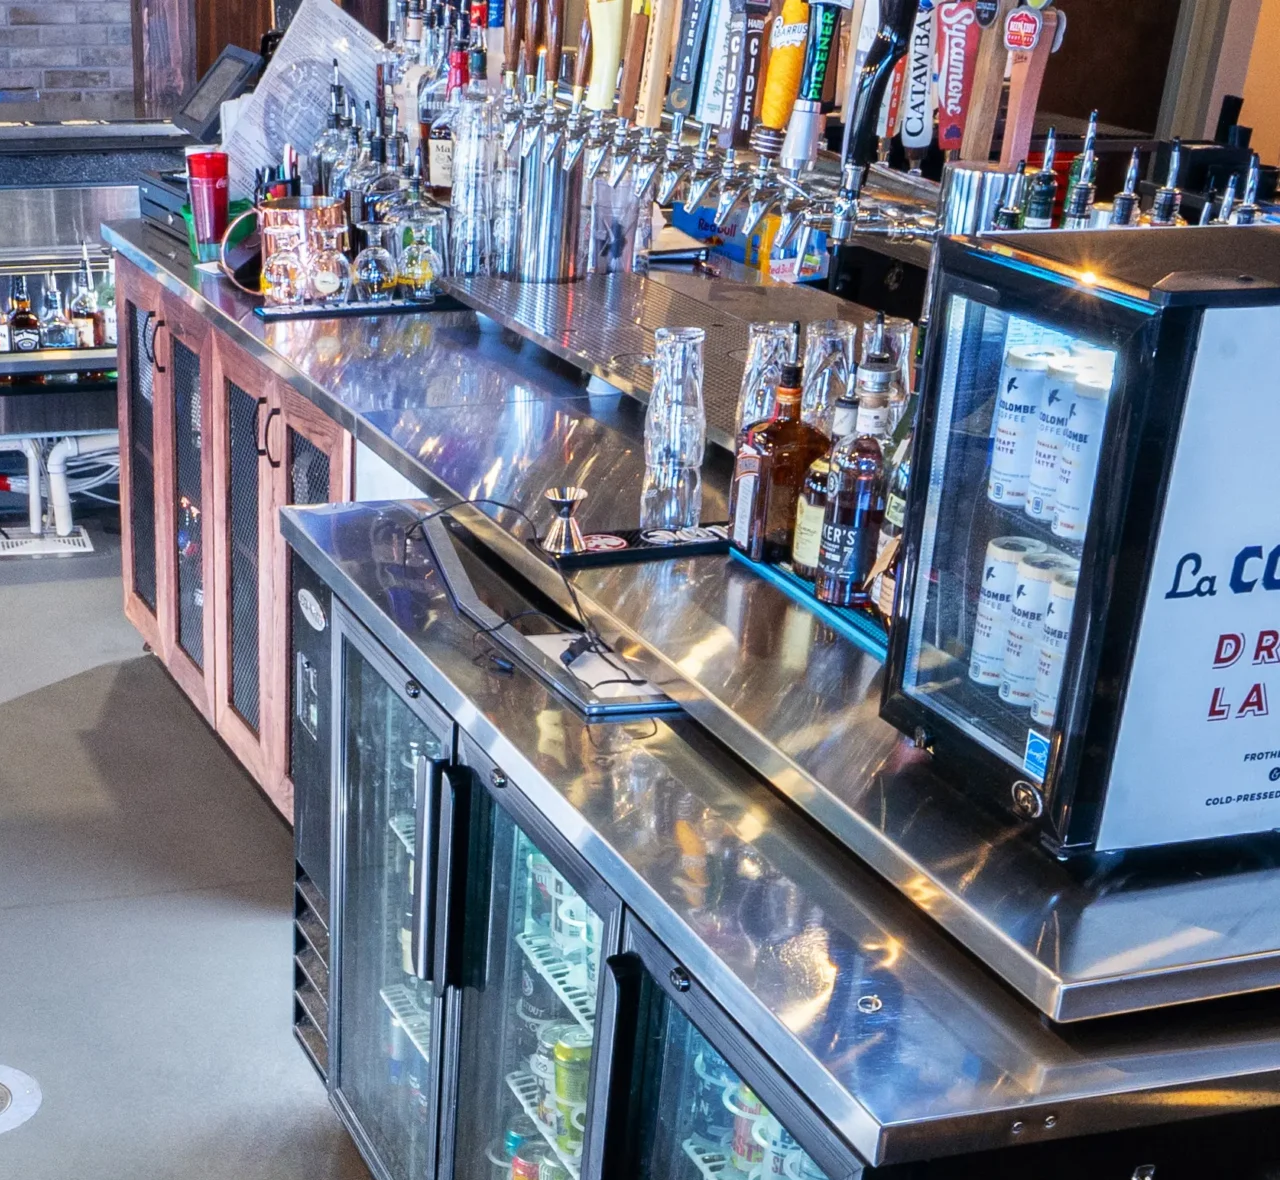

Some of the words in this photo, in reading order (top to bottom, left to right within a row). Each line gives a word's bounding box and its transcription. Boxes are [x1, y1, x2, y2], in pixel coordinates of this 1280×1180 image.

[680, 56, 690, 81] ALE
[721, 35, 741, 129] CIDER
[740, 38, 759, 131] CIDER
[809, 11, 836, 99] PILSENER
[904, 16, 932, 138] CATAWBA
[1165, 552, 1218, 600] La
[1207, 683, 1269, 722] LA
[1205, 790, 1280, 807] COLD-PRESSED
